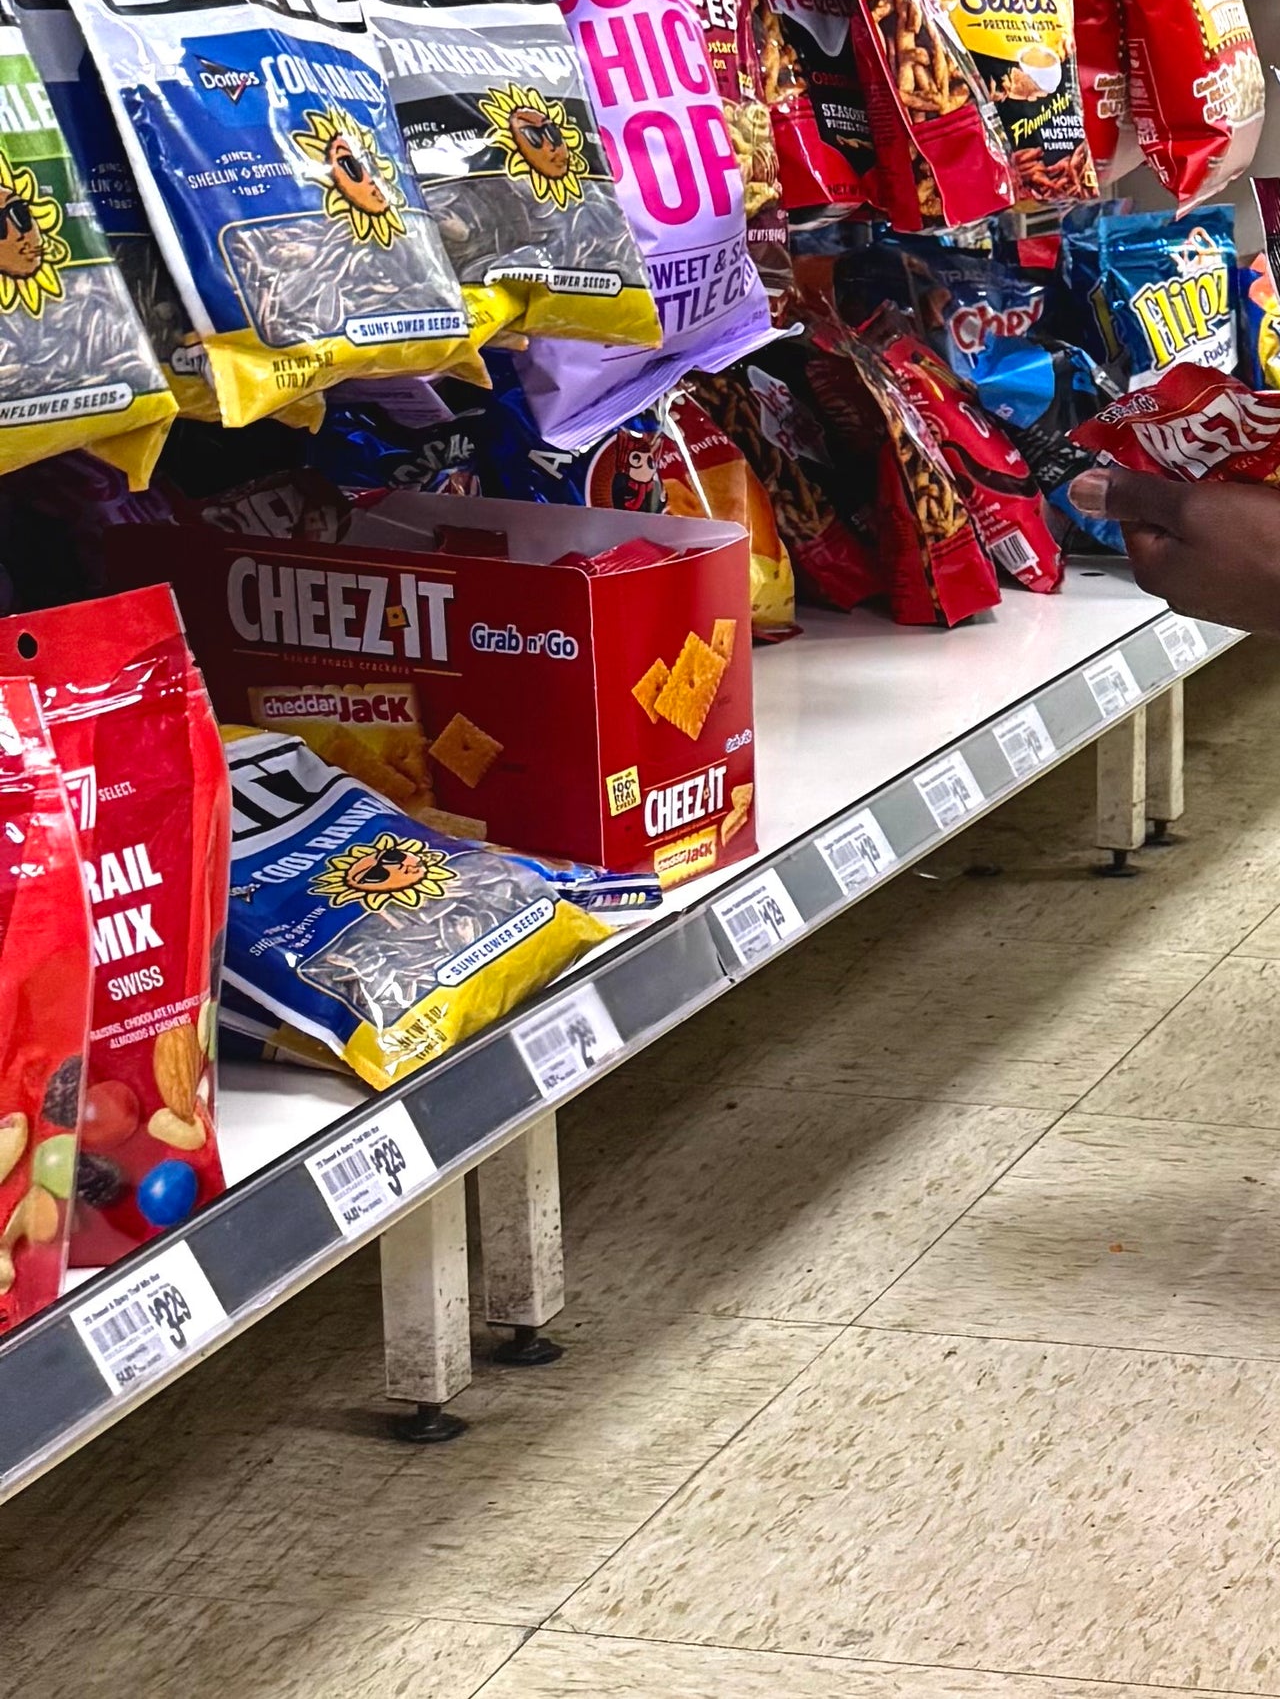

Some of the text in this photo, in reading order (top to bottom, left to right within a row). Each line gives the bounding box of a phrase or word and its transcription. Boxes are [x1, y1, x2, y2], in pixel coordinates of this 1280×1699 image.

[984, 18, 1018, 33] PRETZEL
[219, 151, 258, 165] SINCE
[714, 248, 728, 268] &
[359, 314, 462, 337] SUNFLOWER SEEDS
[0, 389, 119, 419] NFLOWER SEEDS
[470, 622, 521, 654] Grab
[546, 633, 579, 660] Go
[263, 693, 338, 717] cheddar
[82, 842, 164, 904] RAIL
[252, 837, 323, 885] COOL
[451, 904, 546, 978] SUNFLOWER SEEDS
[107, 965, 164, 1002] SWISS
[124, 1004, 169, 1031] CHOCOLATE
[109, 1028, 149, 1050] ALMONDS
